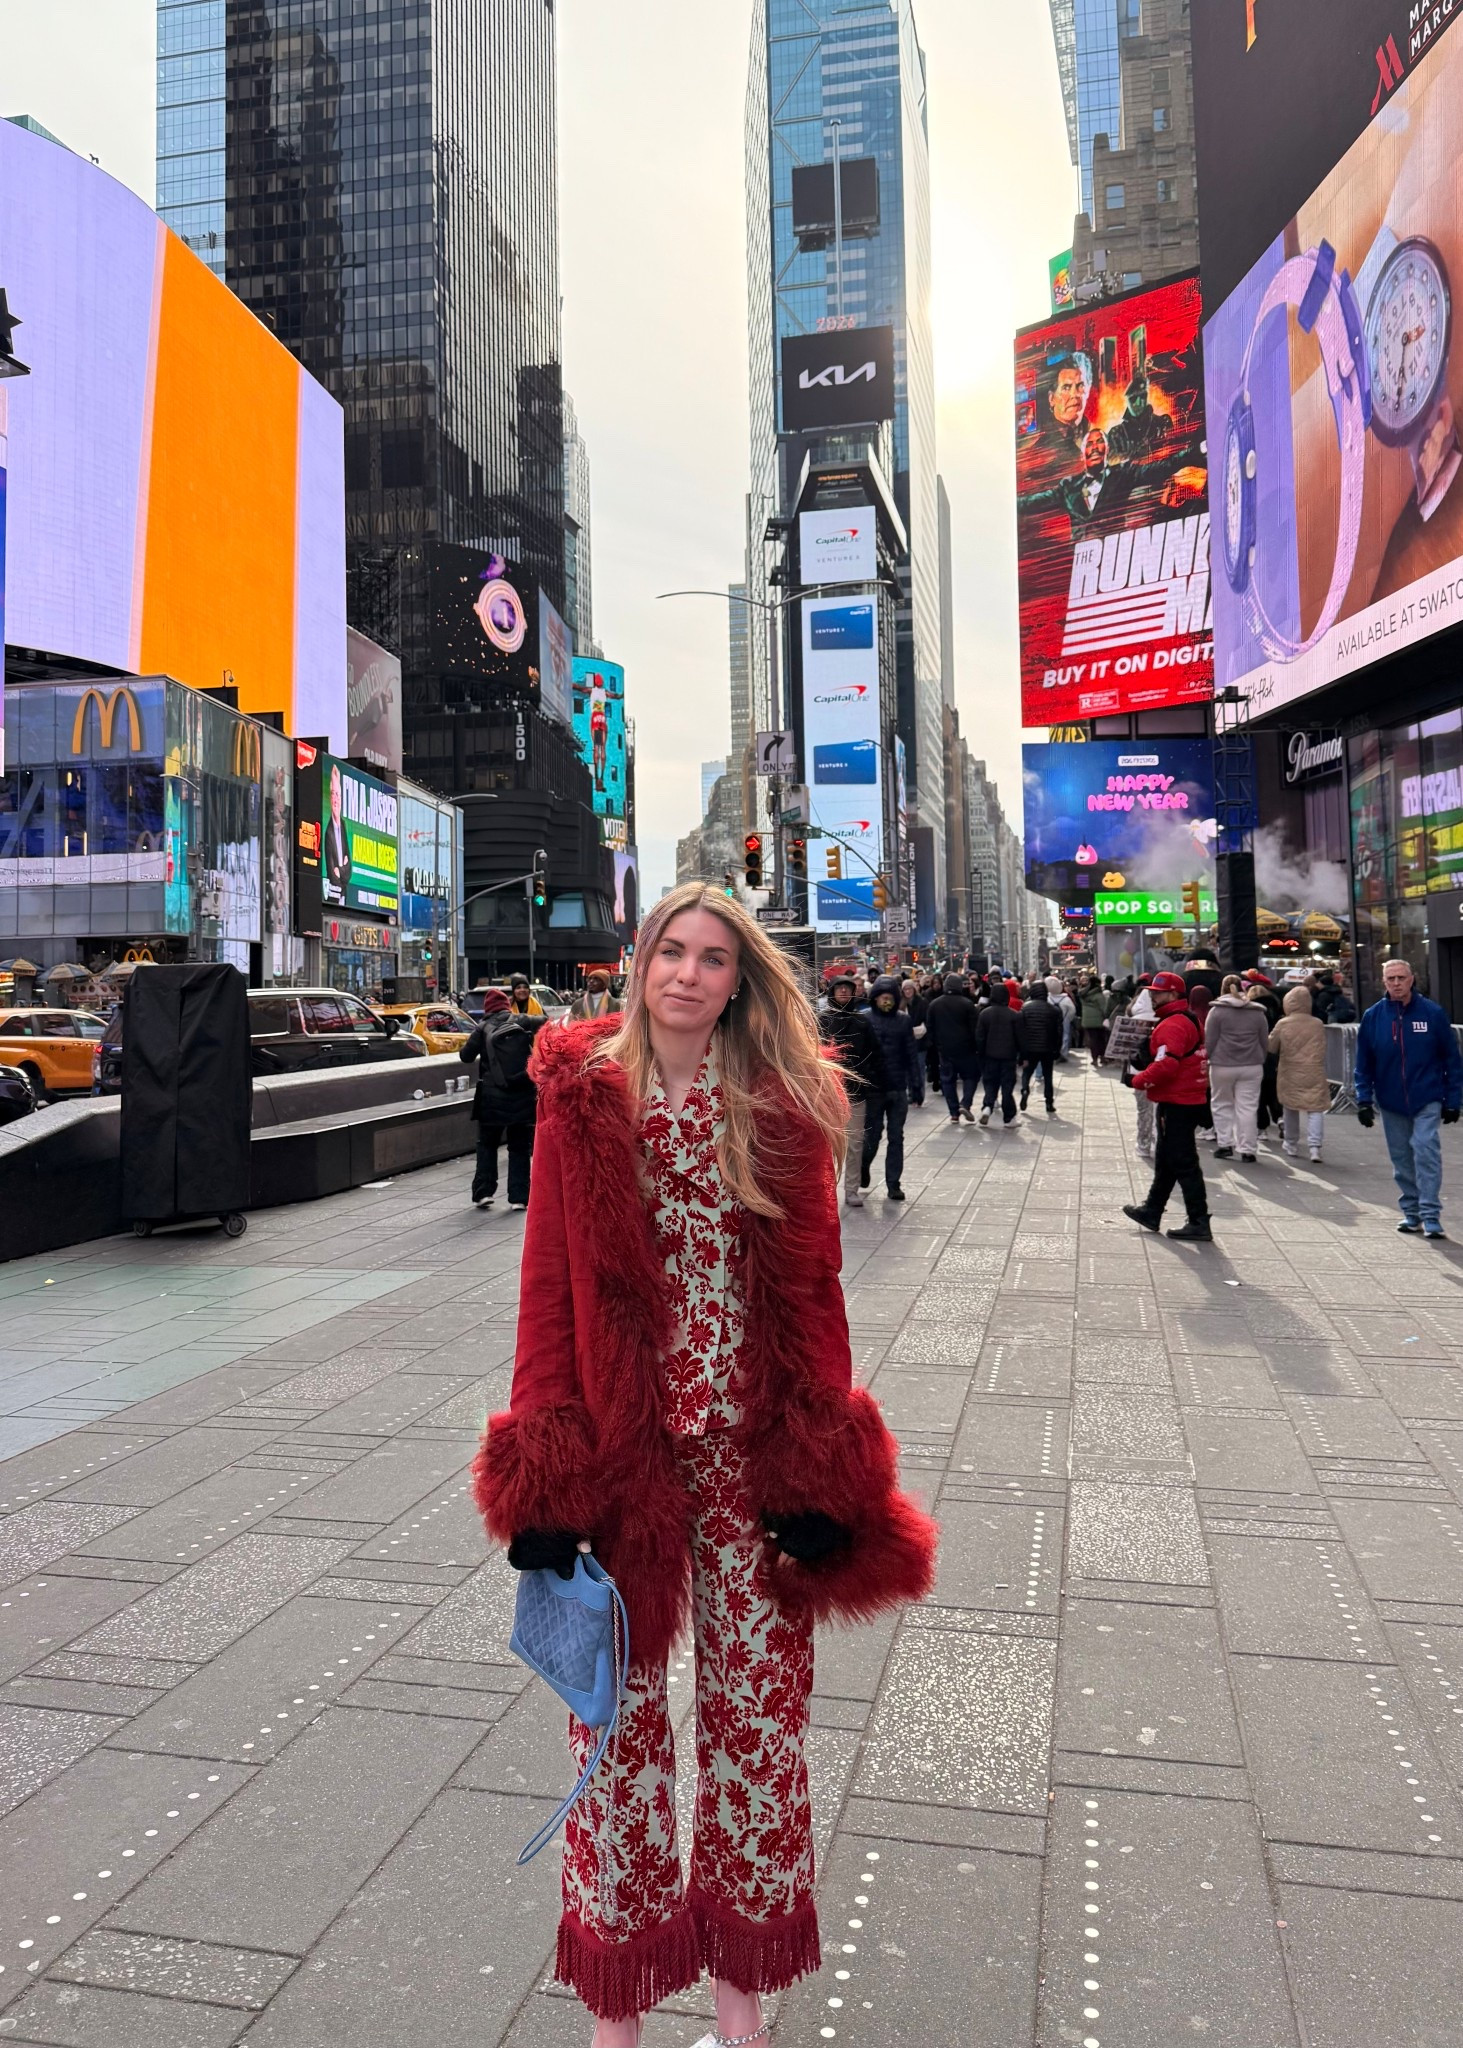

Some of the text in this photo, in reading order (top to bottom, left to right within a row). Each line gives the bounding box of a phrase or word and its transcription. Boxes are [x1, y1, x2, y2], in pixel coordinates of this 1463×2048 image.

[1410, 0, 1434, 29] MA
[1075, 549, 1094, 566] THE
[1337, 612, 1397, 661] AVAILABLE
[1400, 603, 1416, 630] AT
[1043, 664, 1086, 688] BUY
[1090, 660, 1111, 680] IT
[1114, 653, 1149, 675] ON
[515, 712, 526, 761] 1500
[762, 762, 788, 772] ONLY
[1106, 774, 1175, 792] HAPPY
[367, 787, 398, 837] JASPER
[1087, 792, 1189, 812] NEW YEAR
[412, 867, 429, 895] OLD
[353, 924, 378, 947] GIFTS
[889, 922, 906, 932] 25
